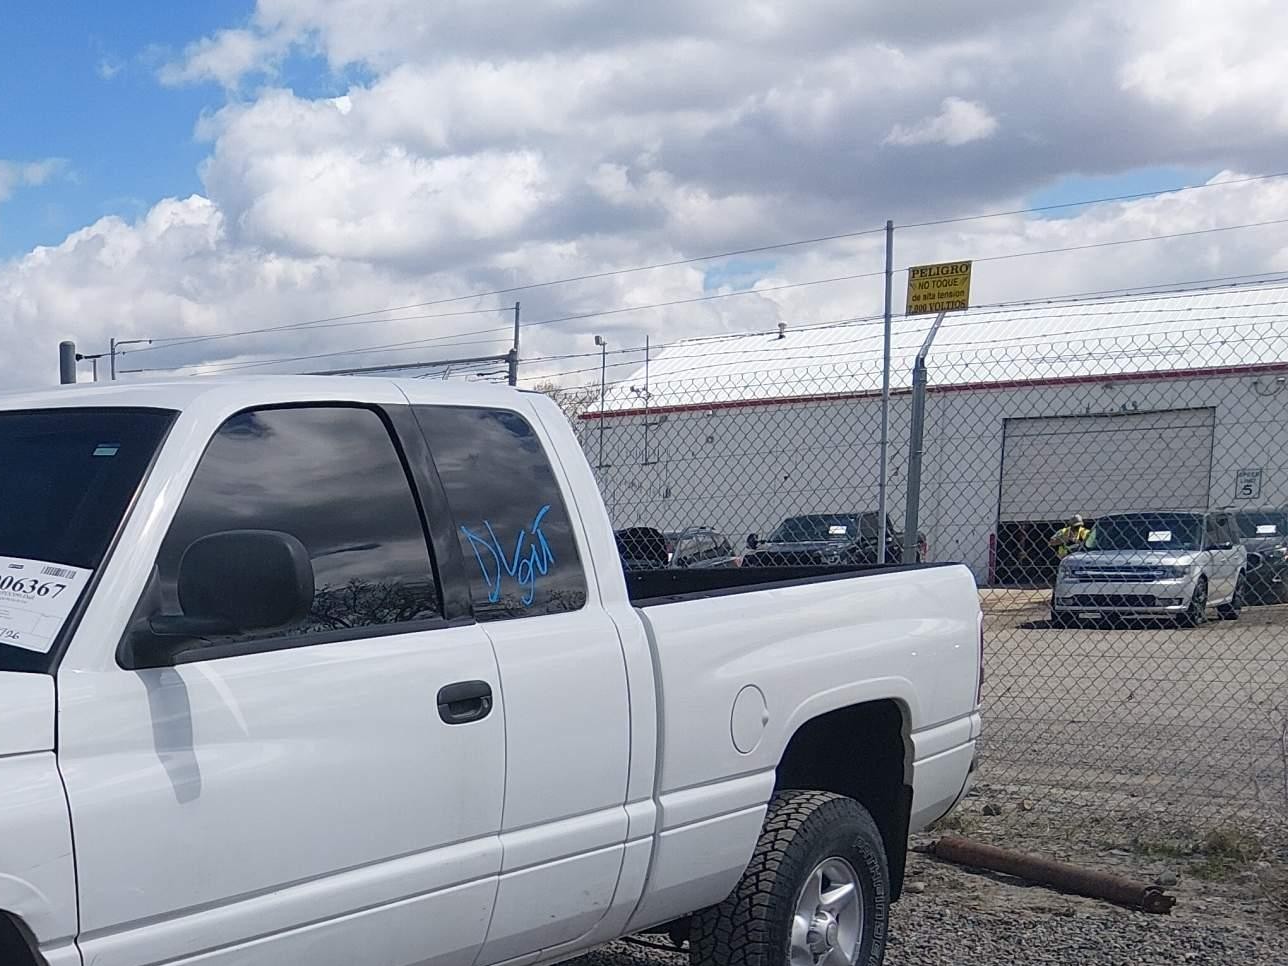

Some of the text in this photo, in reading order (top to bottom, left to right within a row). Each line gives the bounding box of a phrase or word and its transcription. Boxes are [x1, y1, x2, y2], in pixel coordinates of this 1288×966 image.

[911, 264, 969, 279] PELIGRO
[918, 278, 959, 290] NO TOQUE
[929, 300, 967, 312] VOLTIOS
[1242, 484, 1253, 496] 5
